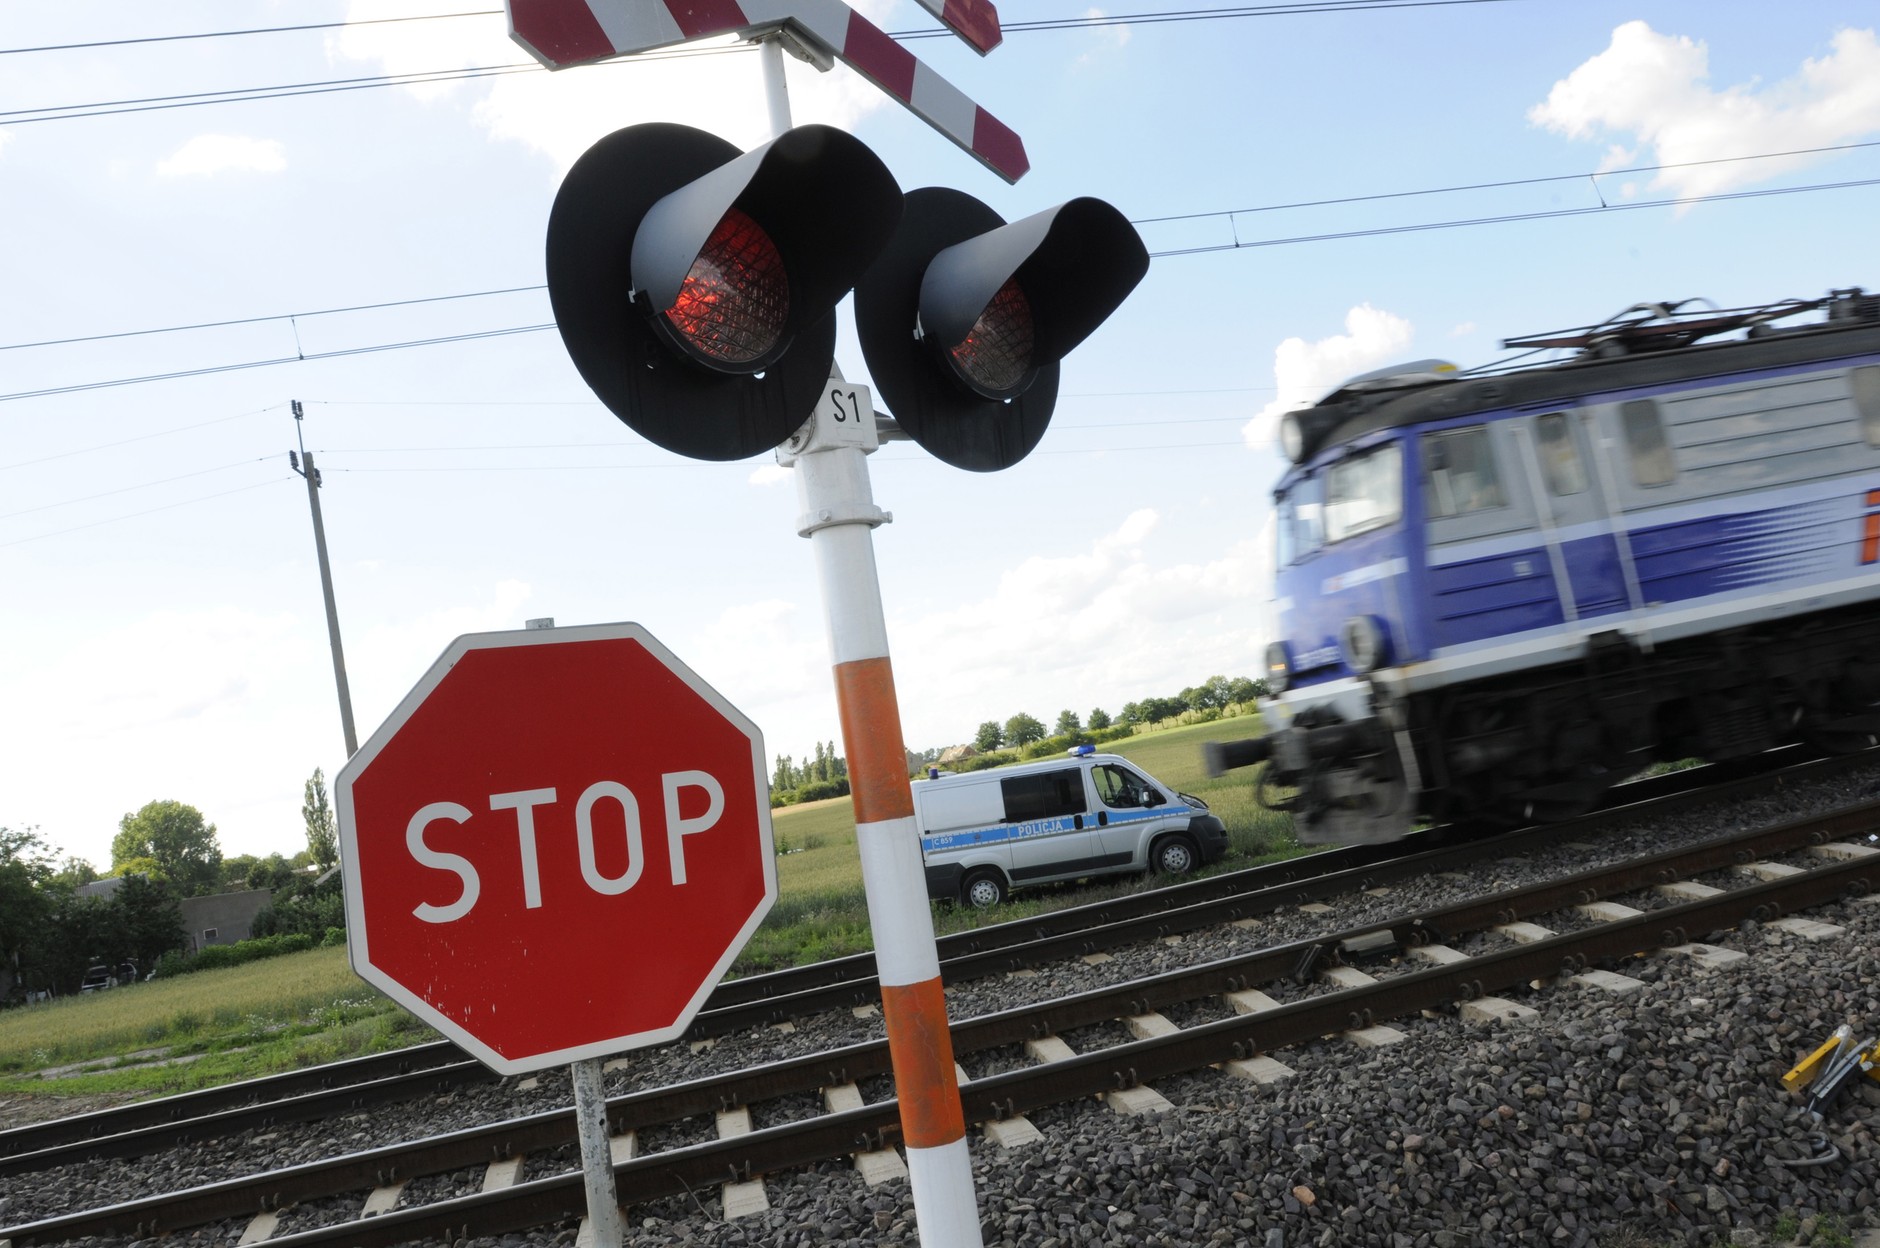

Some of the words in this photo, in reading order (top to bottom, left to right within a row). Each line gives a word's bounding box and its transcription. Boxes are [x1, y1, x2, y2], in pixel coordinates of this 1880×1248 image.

[831, 389, 860, 423] S1
[1017, 820, 1063, 837] POLICJA
[405, 769, 725, 923] STOP
